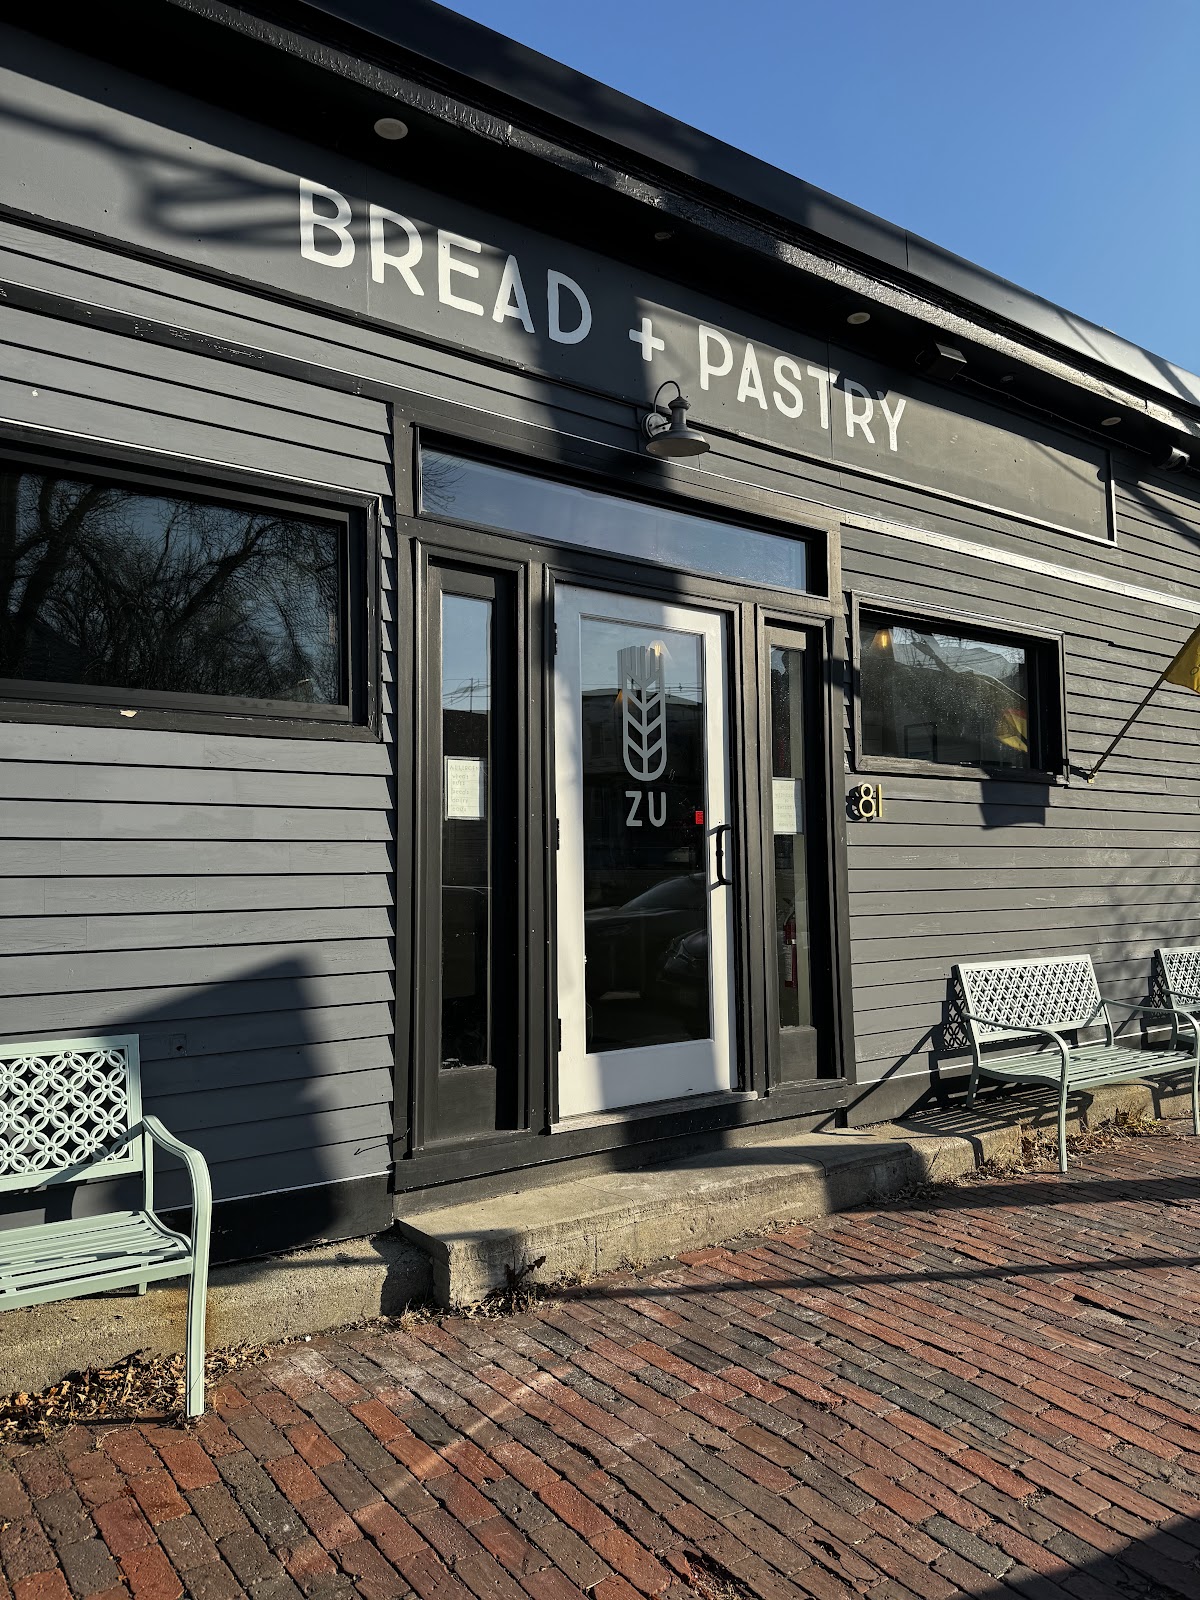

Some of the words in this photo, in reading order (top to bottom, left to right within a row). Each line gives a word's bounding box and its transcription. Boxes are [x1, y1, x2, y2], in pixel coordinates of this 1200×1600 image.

[300, 177, 592, 344] BREAD
[628, 317, 665, 362] +
[698, 324, 907, 452] PASTRY
[625, 790, 667, 827] ZU
[859, 783, 883, 818] 81
